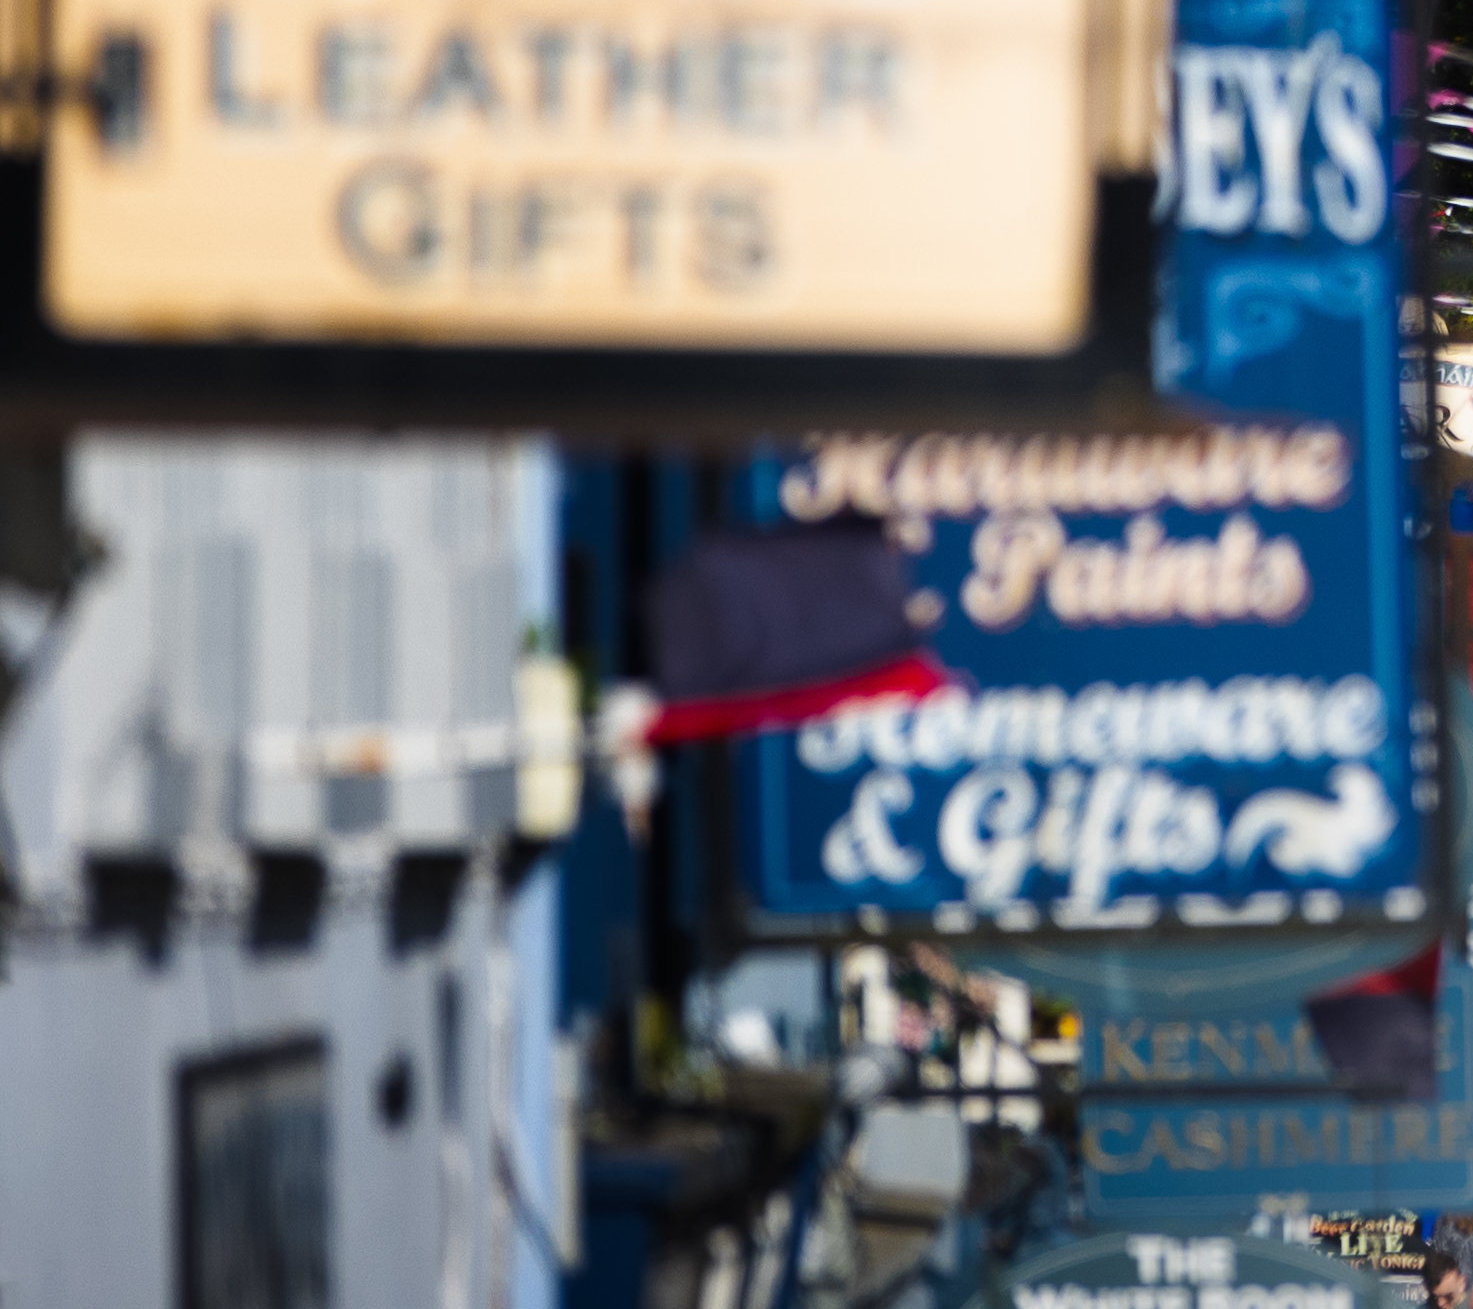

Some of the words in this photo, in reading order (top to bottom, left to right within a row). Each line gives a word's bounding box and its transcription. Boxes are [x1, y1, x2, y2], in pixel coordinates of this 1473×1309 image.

[206, 14, 905, 129] LEATHER
[1153, 29, 1388, 244] EY'S
[335, 157, 777, 289] GIFTS
[1126, 1234, 1236, 1283] THE
